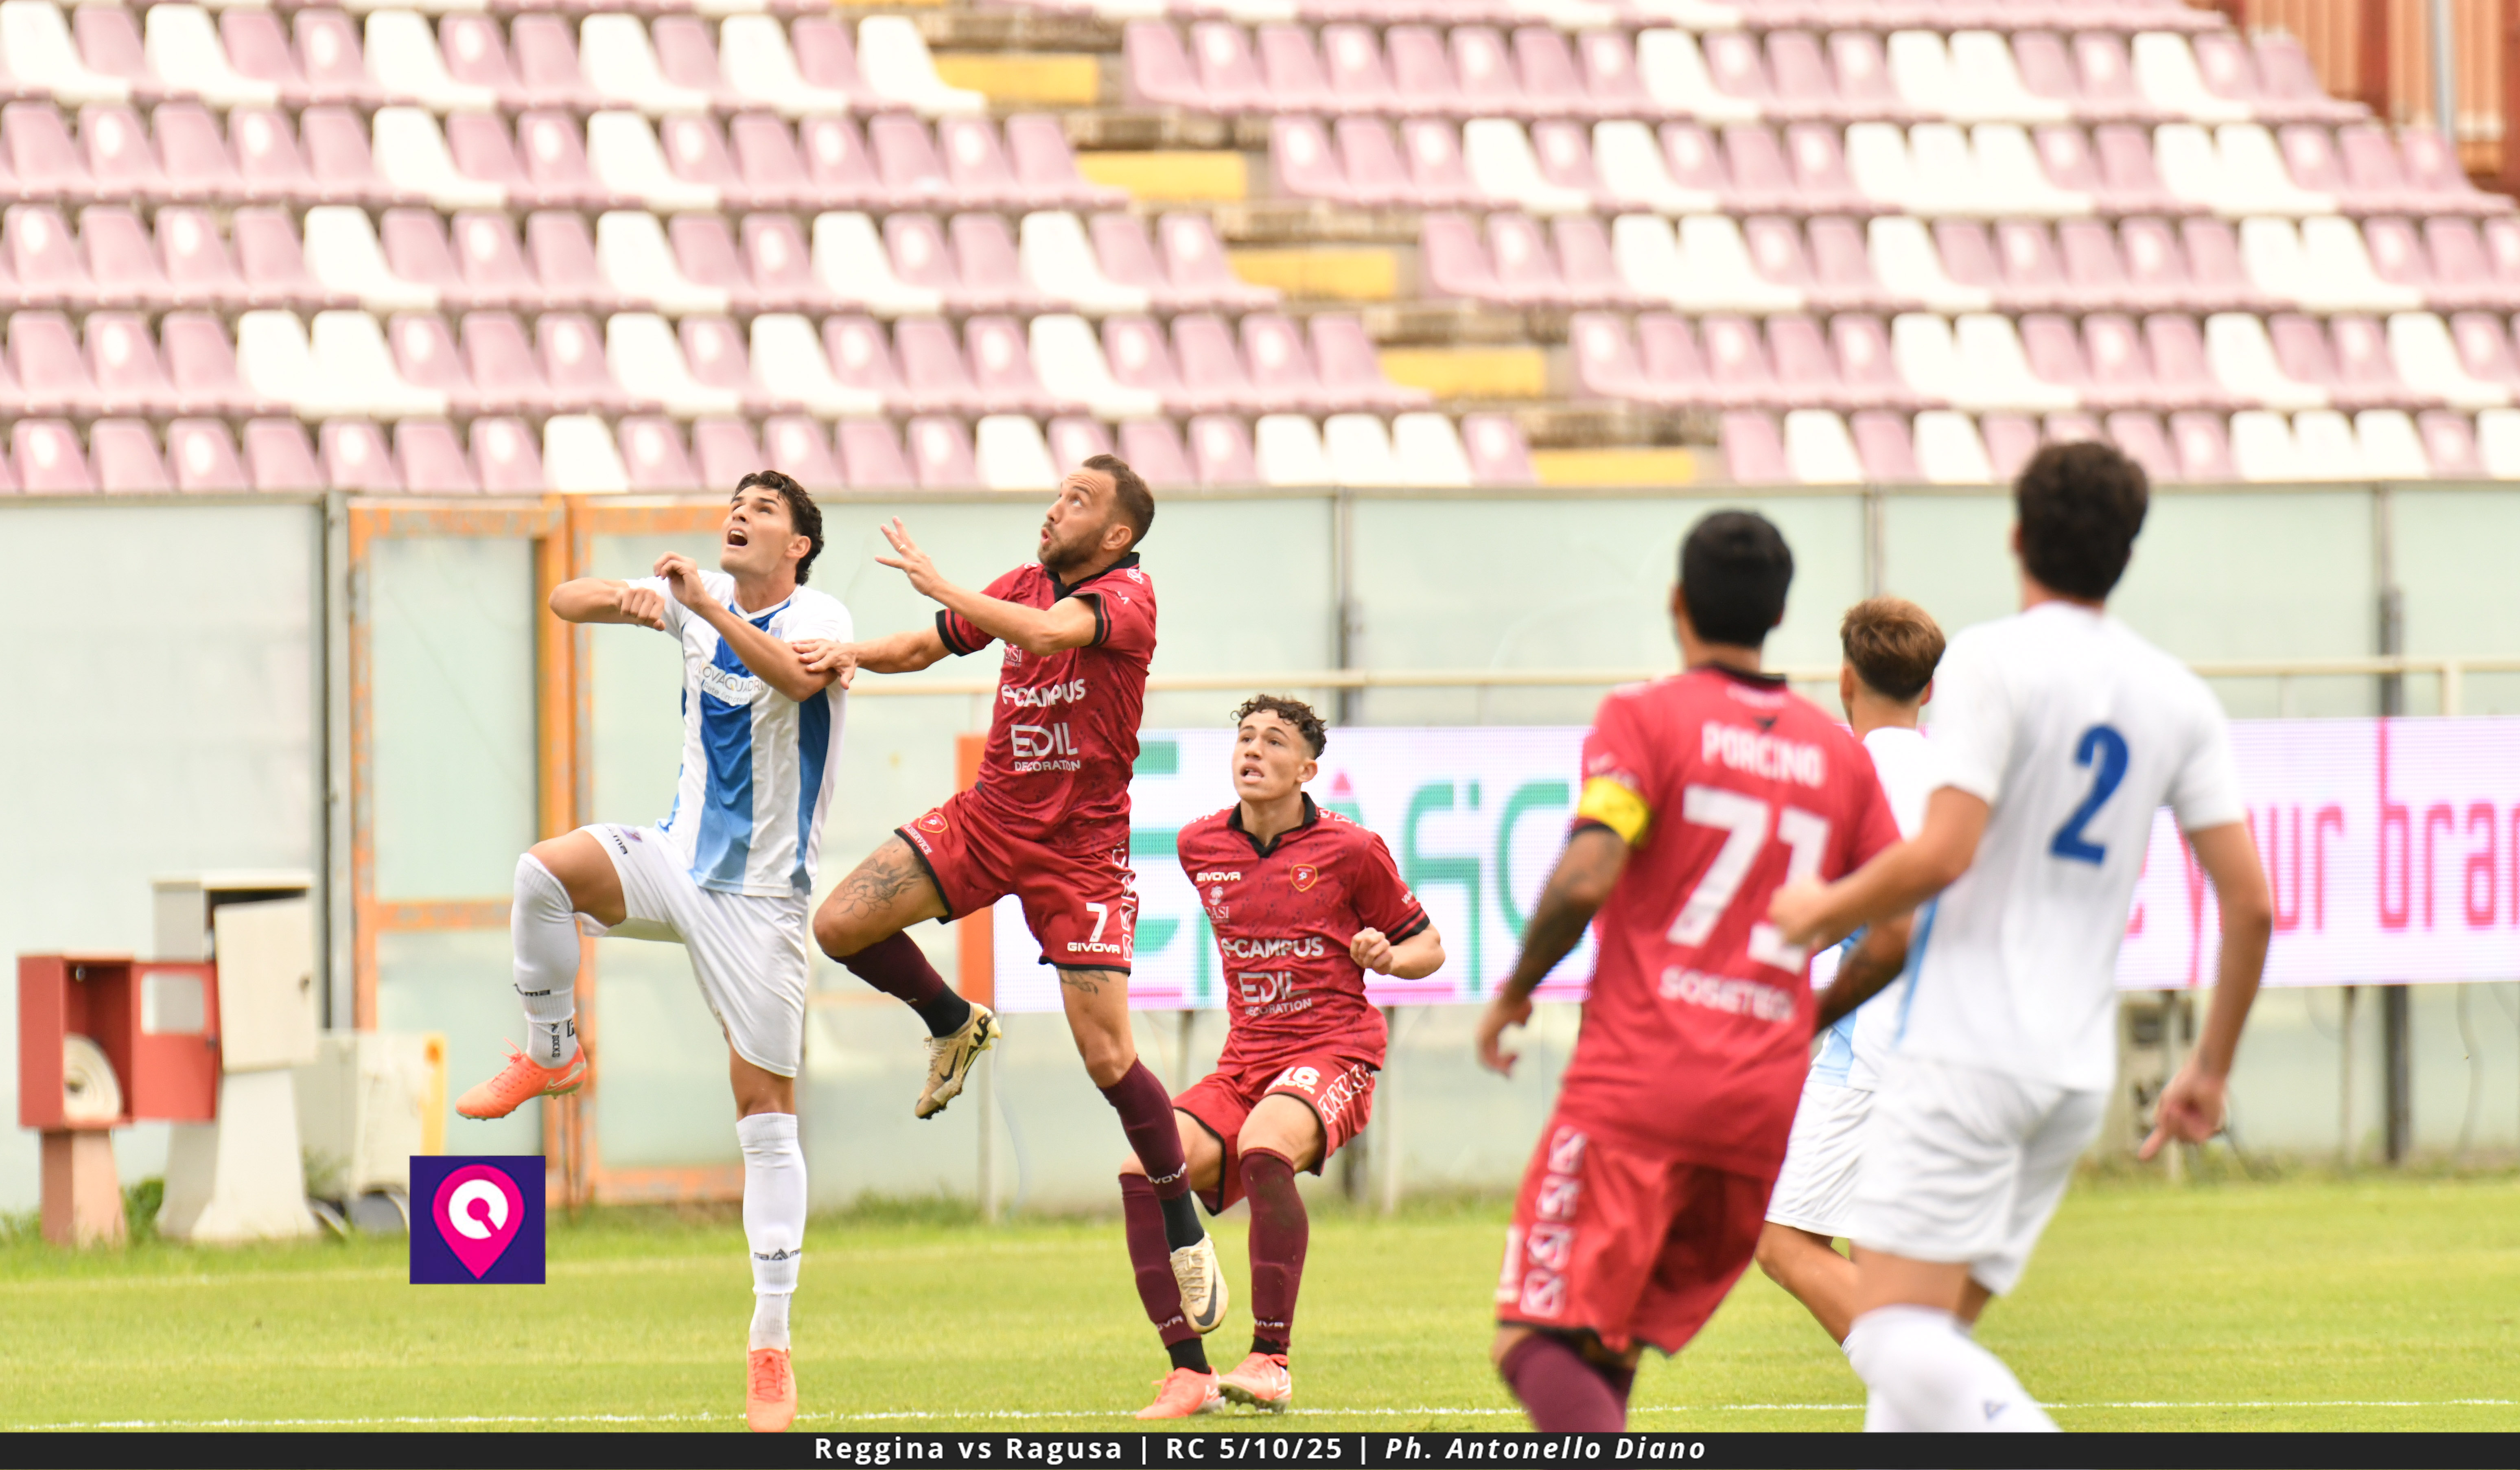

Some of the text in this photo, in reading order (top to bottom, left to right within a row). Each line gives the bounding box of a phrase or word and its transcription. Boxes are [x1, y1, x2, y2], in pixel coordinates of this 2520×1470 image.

[1011, 722, 1078, 757] EDIL
[1701, 719, 1826, 789] PORCINO
[2052, 723, 2129, 867] 2
[1197, 871, 1241, 882] GIVOVA
[1666, 782, 1831, 975] 71
[1085, 902, 1107, 943] 7
[1067, 942, 1120, 954] GIVOVA
[1237, 971, 1310, 1003] EDIL
